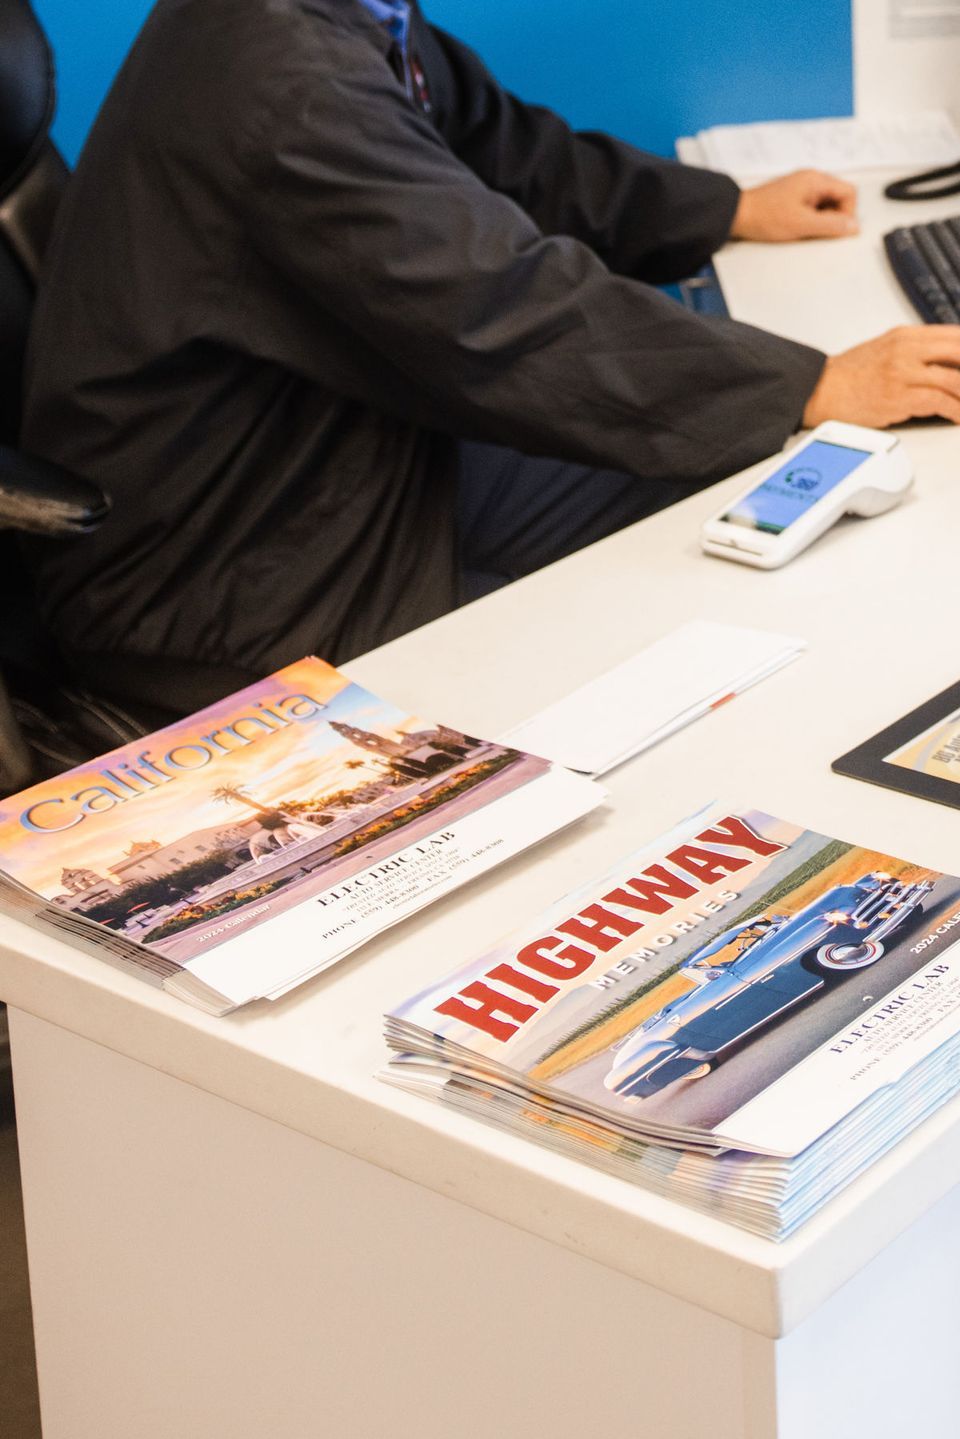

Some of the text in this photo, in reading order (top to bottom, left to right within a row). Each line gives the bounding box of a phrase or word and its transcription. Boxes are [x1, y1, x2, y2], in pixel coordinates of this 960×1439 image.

[19, 693, 328, 834] California
[317, 831, 455, 906] ELECTRIC LAB
[322, 918, 357, 940] PHONE
[432, 815, 790, 1044] HIGHWAY
[588, 888, 742, 991] MEMORIES
[910, 932, 938, 954] 2024
[829, 991, 915, 1054] ELECTRIC
[912, 964, 950, 990] LAB
